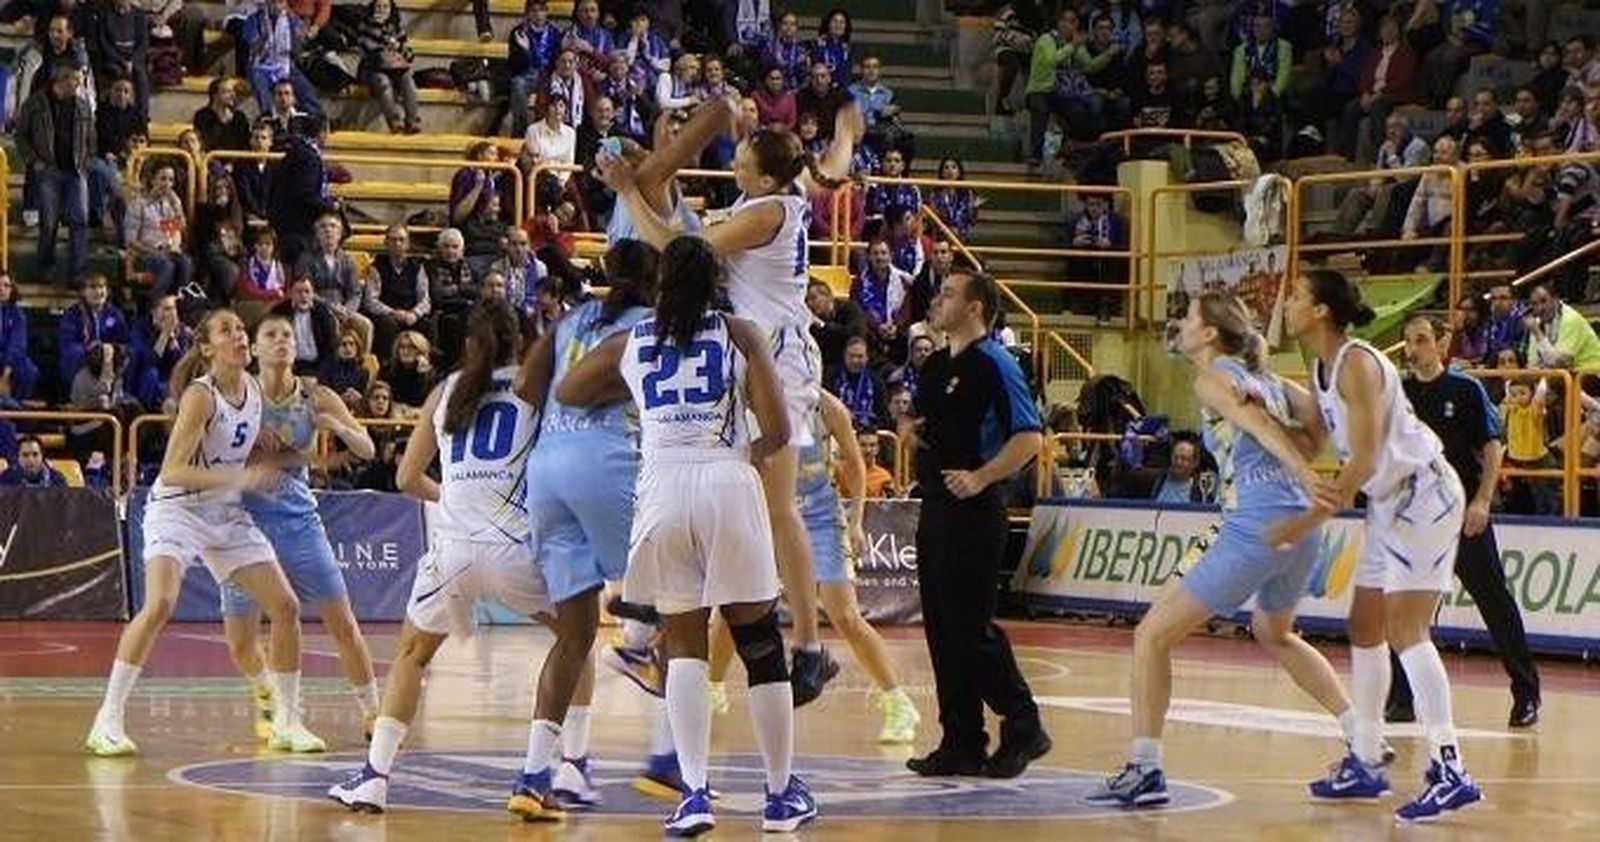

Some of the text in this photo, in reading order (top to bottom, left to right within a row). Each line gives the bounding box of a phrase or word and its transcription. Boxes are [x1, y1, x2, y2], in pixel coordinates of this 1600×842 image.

[638, 339, 723, 410] 23
[231, 422, 248, 448] 5
[451, 402, 519, 464] 10
[338, 542, 398, 561] INE
[356, 561, 398, 570] YORK
[868, 532, 918, 570] Kle
[1443, 550, 1600, 614] ROLA
